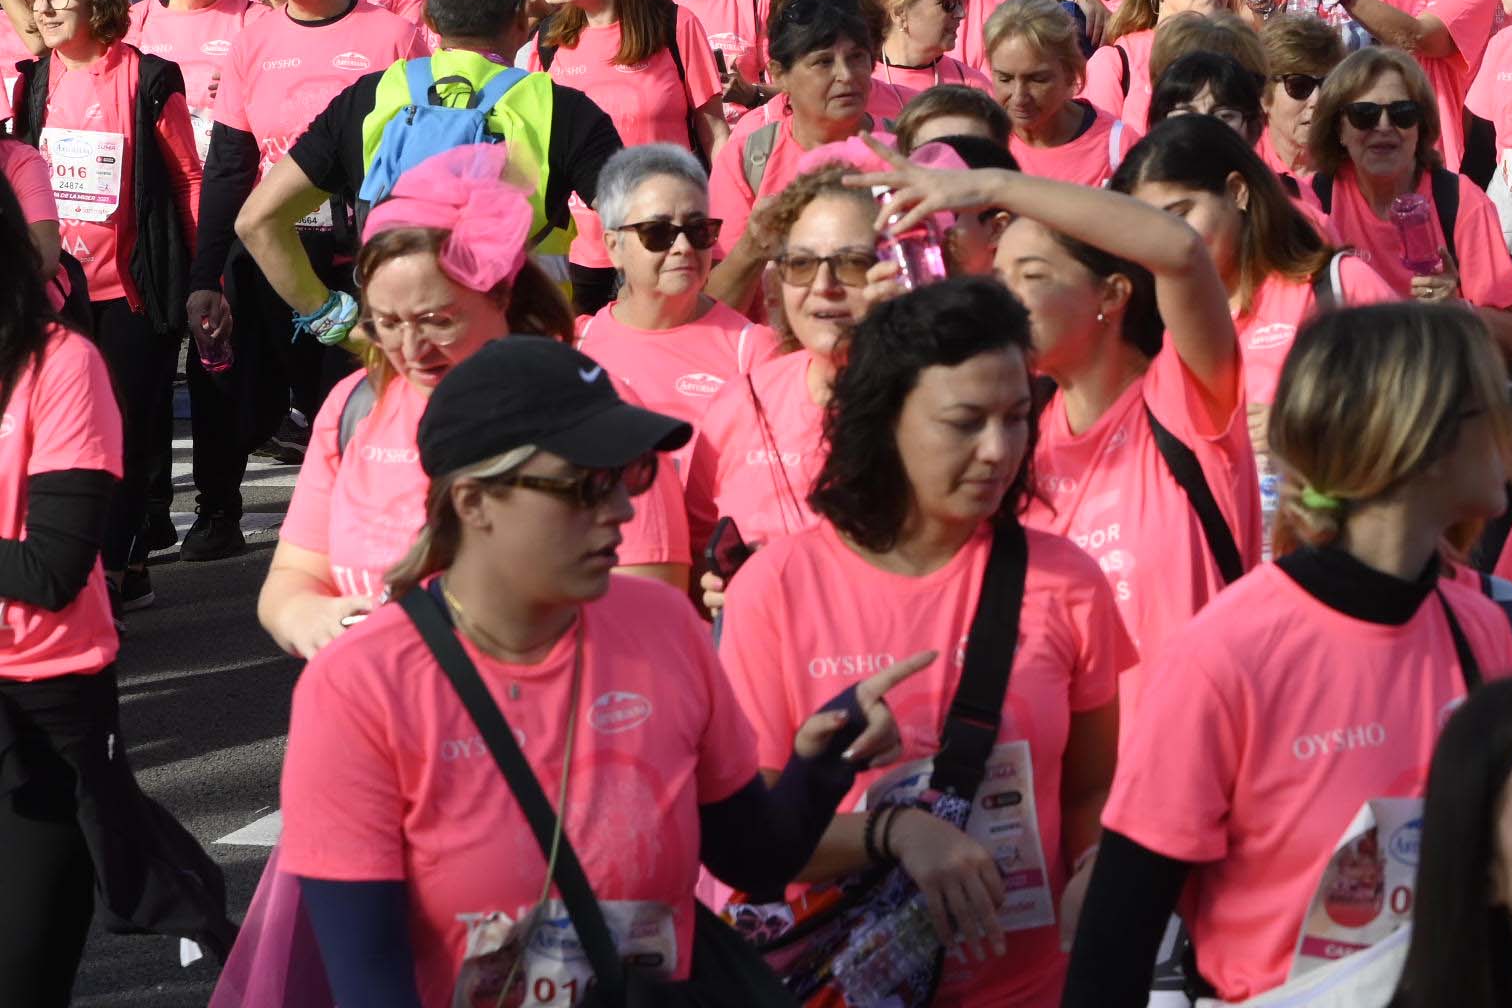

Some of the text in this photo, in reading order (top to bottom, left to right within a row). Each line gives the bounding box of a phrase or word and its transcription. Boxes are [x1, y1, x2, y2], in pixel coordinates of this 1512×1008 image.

[56, 164, 87, 179] 016
[59, 181, 84, 190] 24874
[807, 652, 895, 680] OYSHO
[1291, 722, 1386, 763] OYSHO
